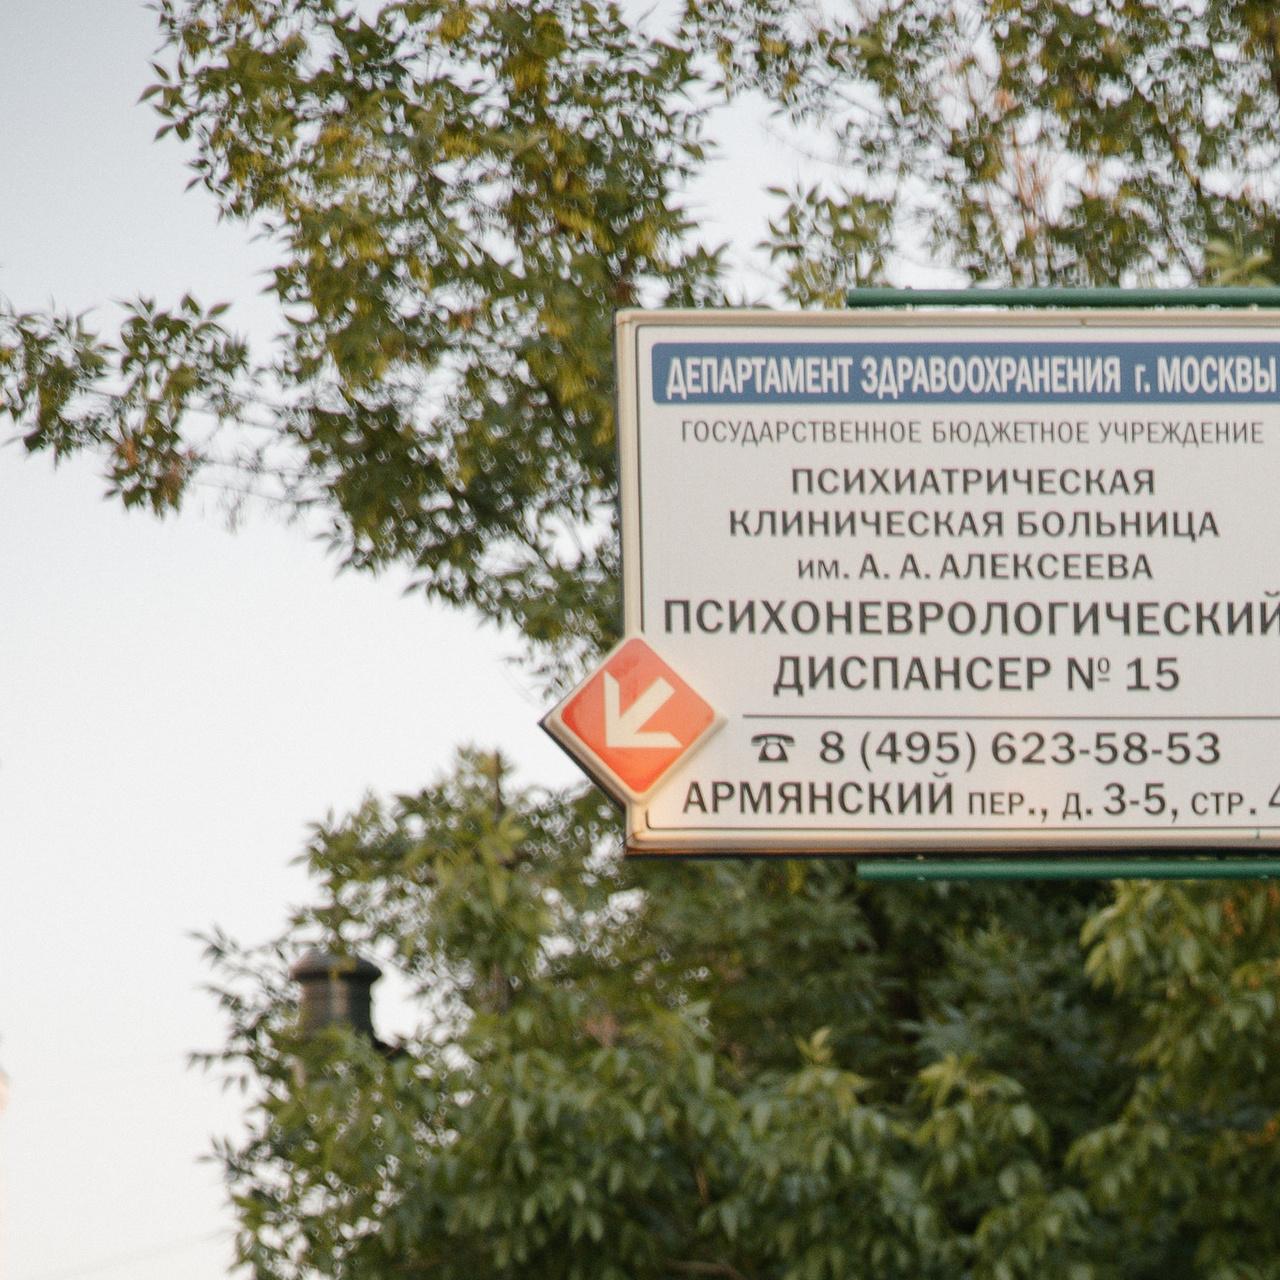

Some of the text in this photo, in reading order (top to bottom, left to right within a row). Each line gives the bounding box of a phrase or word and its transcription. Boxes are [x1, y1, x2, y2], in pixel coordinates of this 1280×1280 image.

[665, 355, 1278, 401] ДЕПАРТАМЕНТ ЗДРАВООХРАНЕНИЯ г. МОСКВЫ
[681, 420, 1264, 448] ГОСУДАРСТВЕННОЕ БЮДЖЕТНОЕ УЧРЕЖДЕНИЕ
[791, 467, 1156, 496] ПСИХИАТРИЧЕСКАЯ
[729, 509, 1221, 543] КЛИНИЧЕСКАЯ БОЛЬНИЦА
[857, 552, 891, 580] А.
[899, 552, 932, 580] А.
[939, 552, 1155, 580] АЛЕКСЕЕВА
[772, 655, 1182, 698] ДИСПАНСЕР № 15
[819, 730, 1222, 773] 8 (495) 623-58-53
[682, 773, 954, 816] АРМЯНСКИЙ
[1103, 782, 1180, 823] 3-5,
